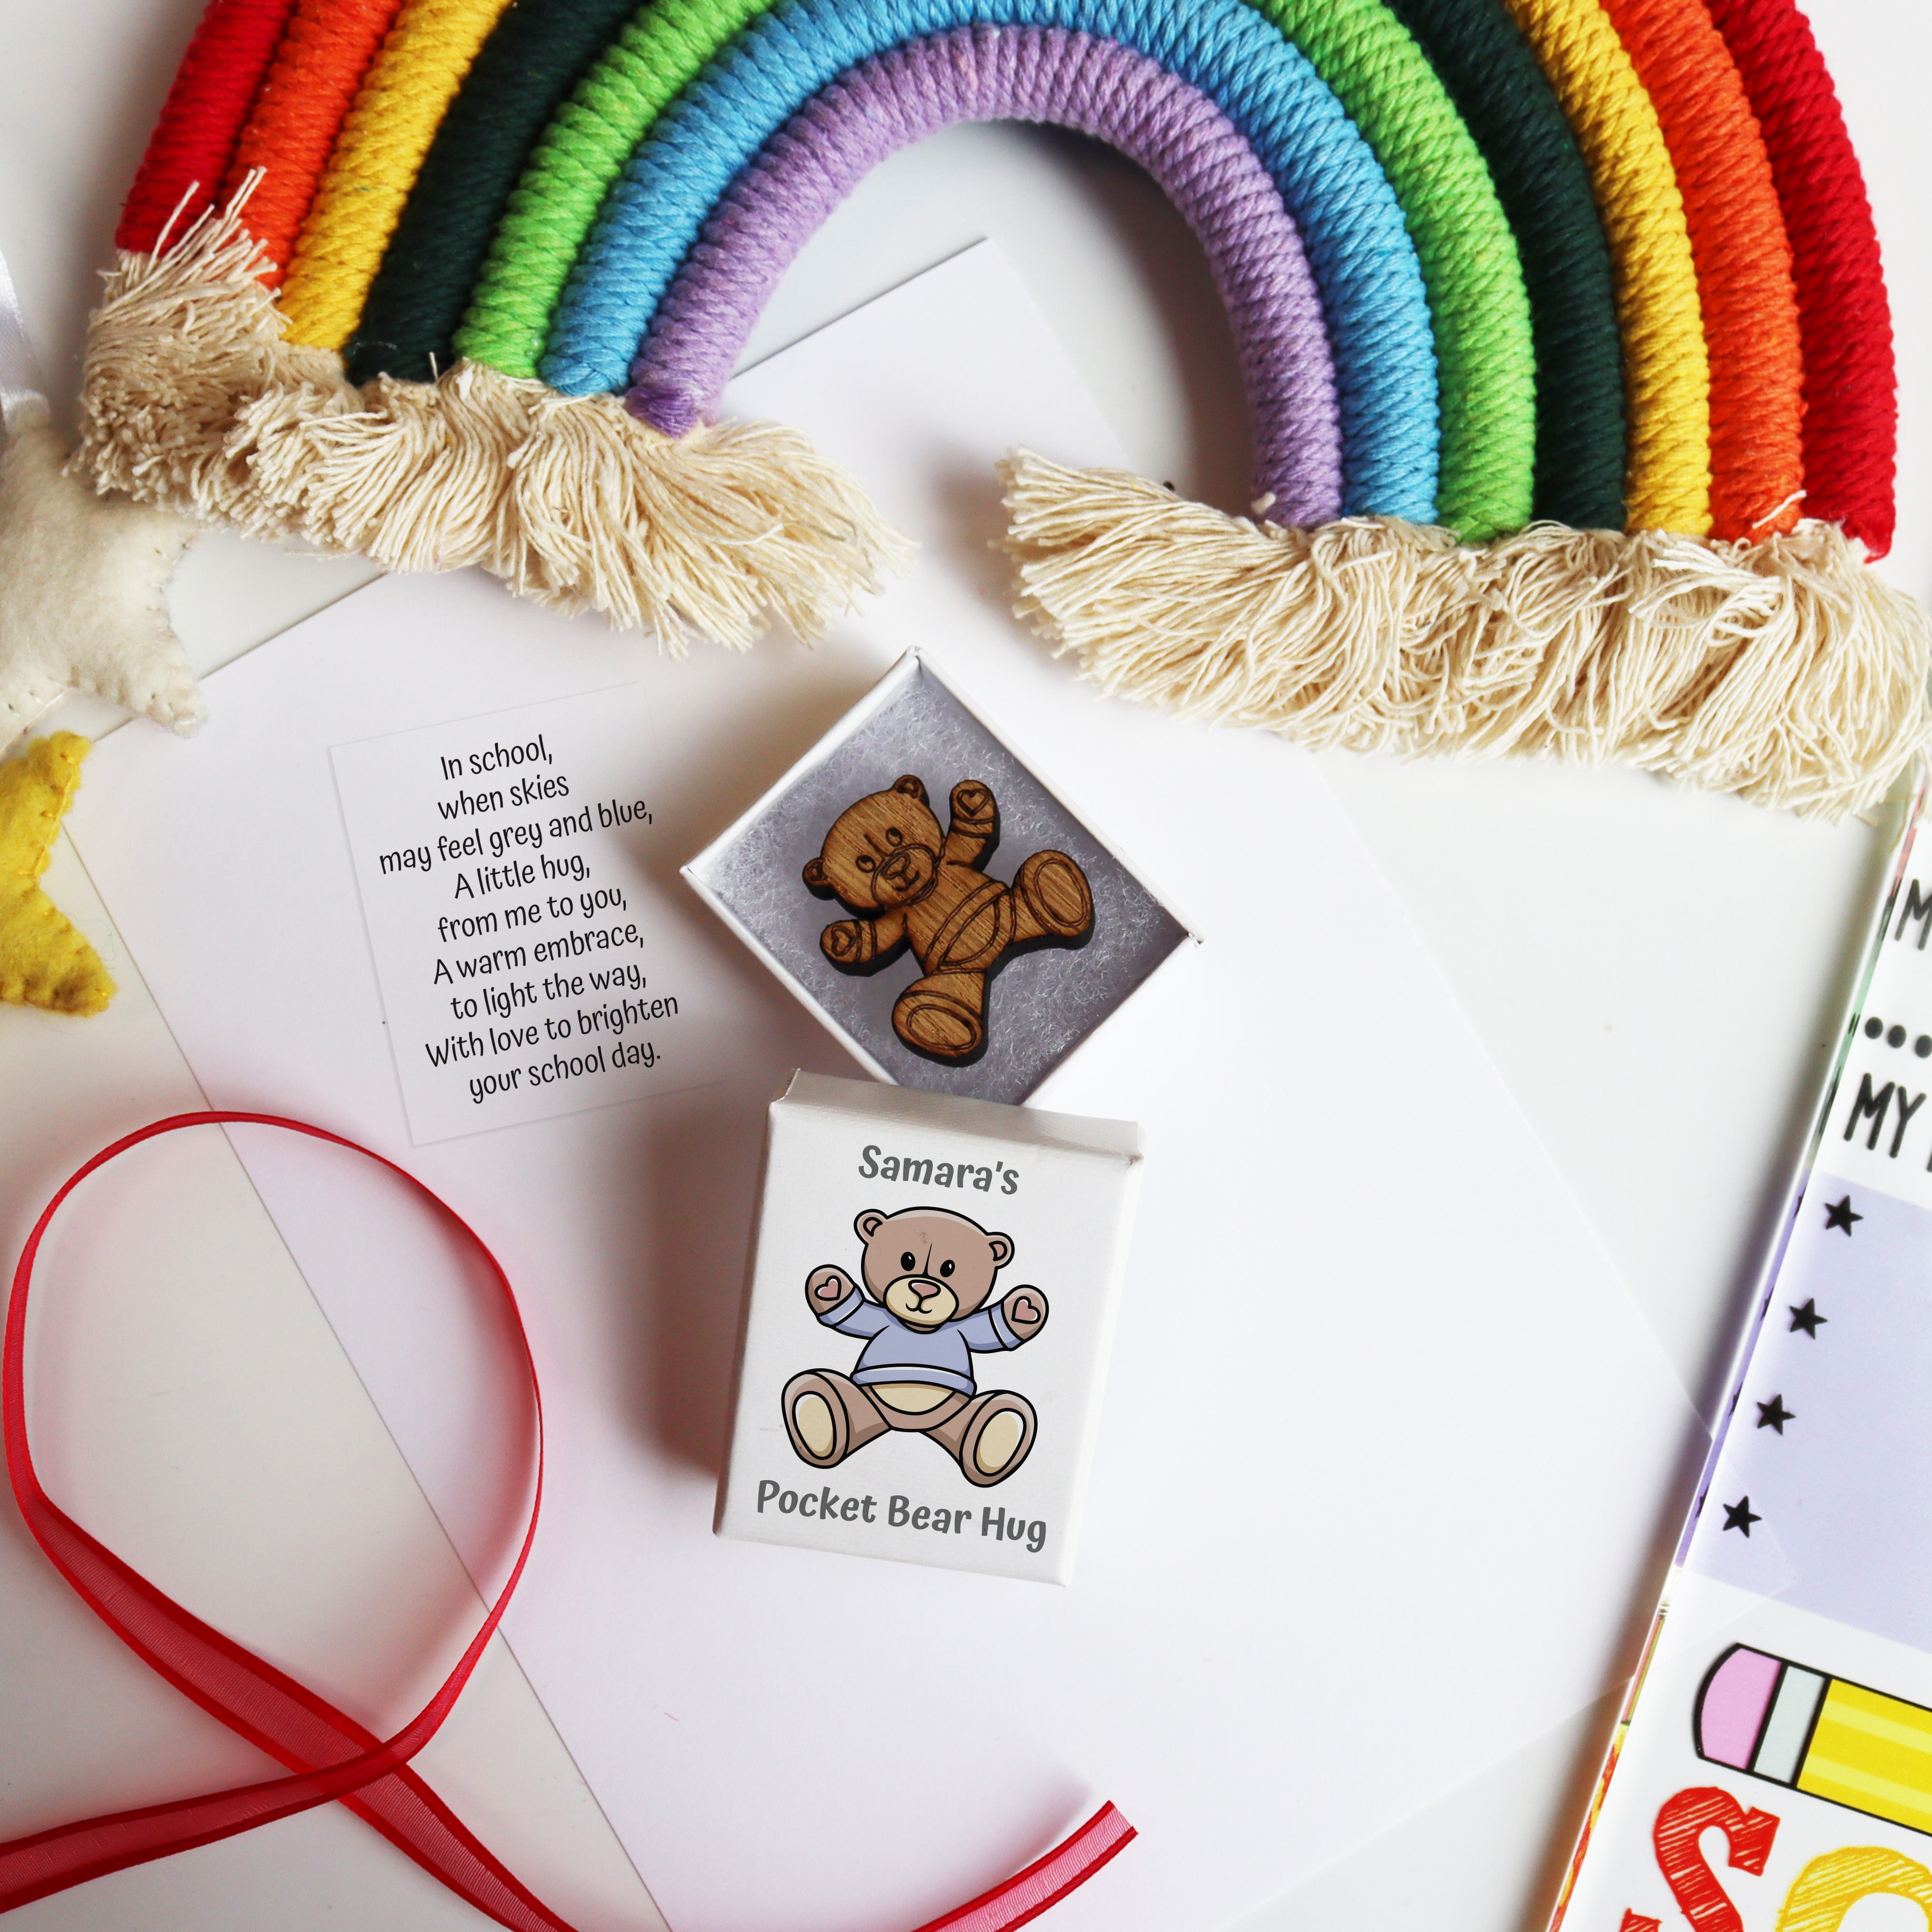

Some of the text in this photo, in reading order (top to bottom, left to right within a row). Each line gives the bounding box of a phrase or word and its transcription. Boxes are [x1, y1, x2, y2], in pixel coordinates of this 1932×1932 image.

[441, 735, 552, 780] In school,
[438, 775, 568, 819] when skies
[380, 799, 652, 874] may feel grey and blue,
[455, 855, 590, 899] A little hug,
[438, 888, 626, 942] from me to you,
[434, 924, 643, 984] A warm embrace,
[451, 965, 645, 1019] to light the way,
[426, 997, 678, 1067] With love to brighten
[470, 1042, 661, 1104] your school day.
[1843, 1073, 1926, 1158] MY
[859, 1145, 1019, 1194] Samara's
[758, 1480, 1046, 1552] Pocket Bear Hug
